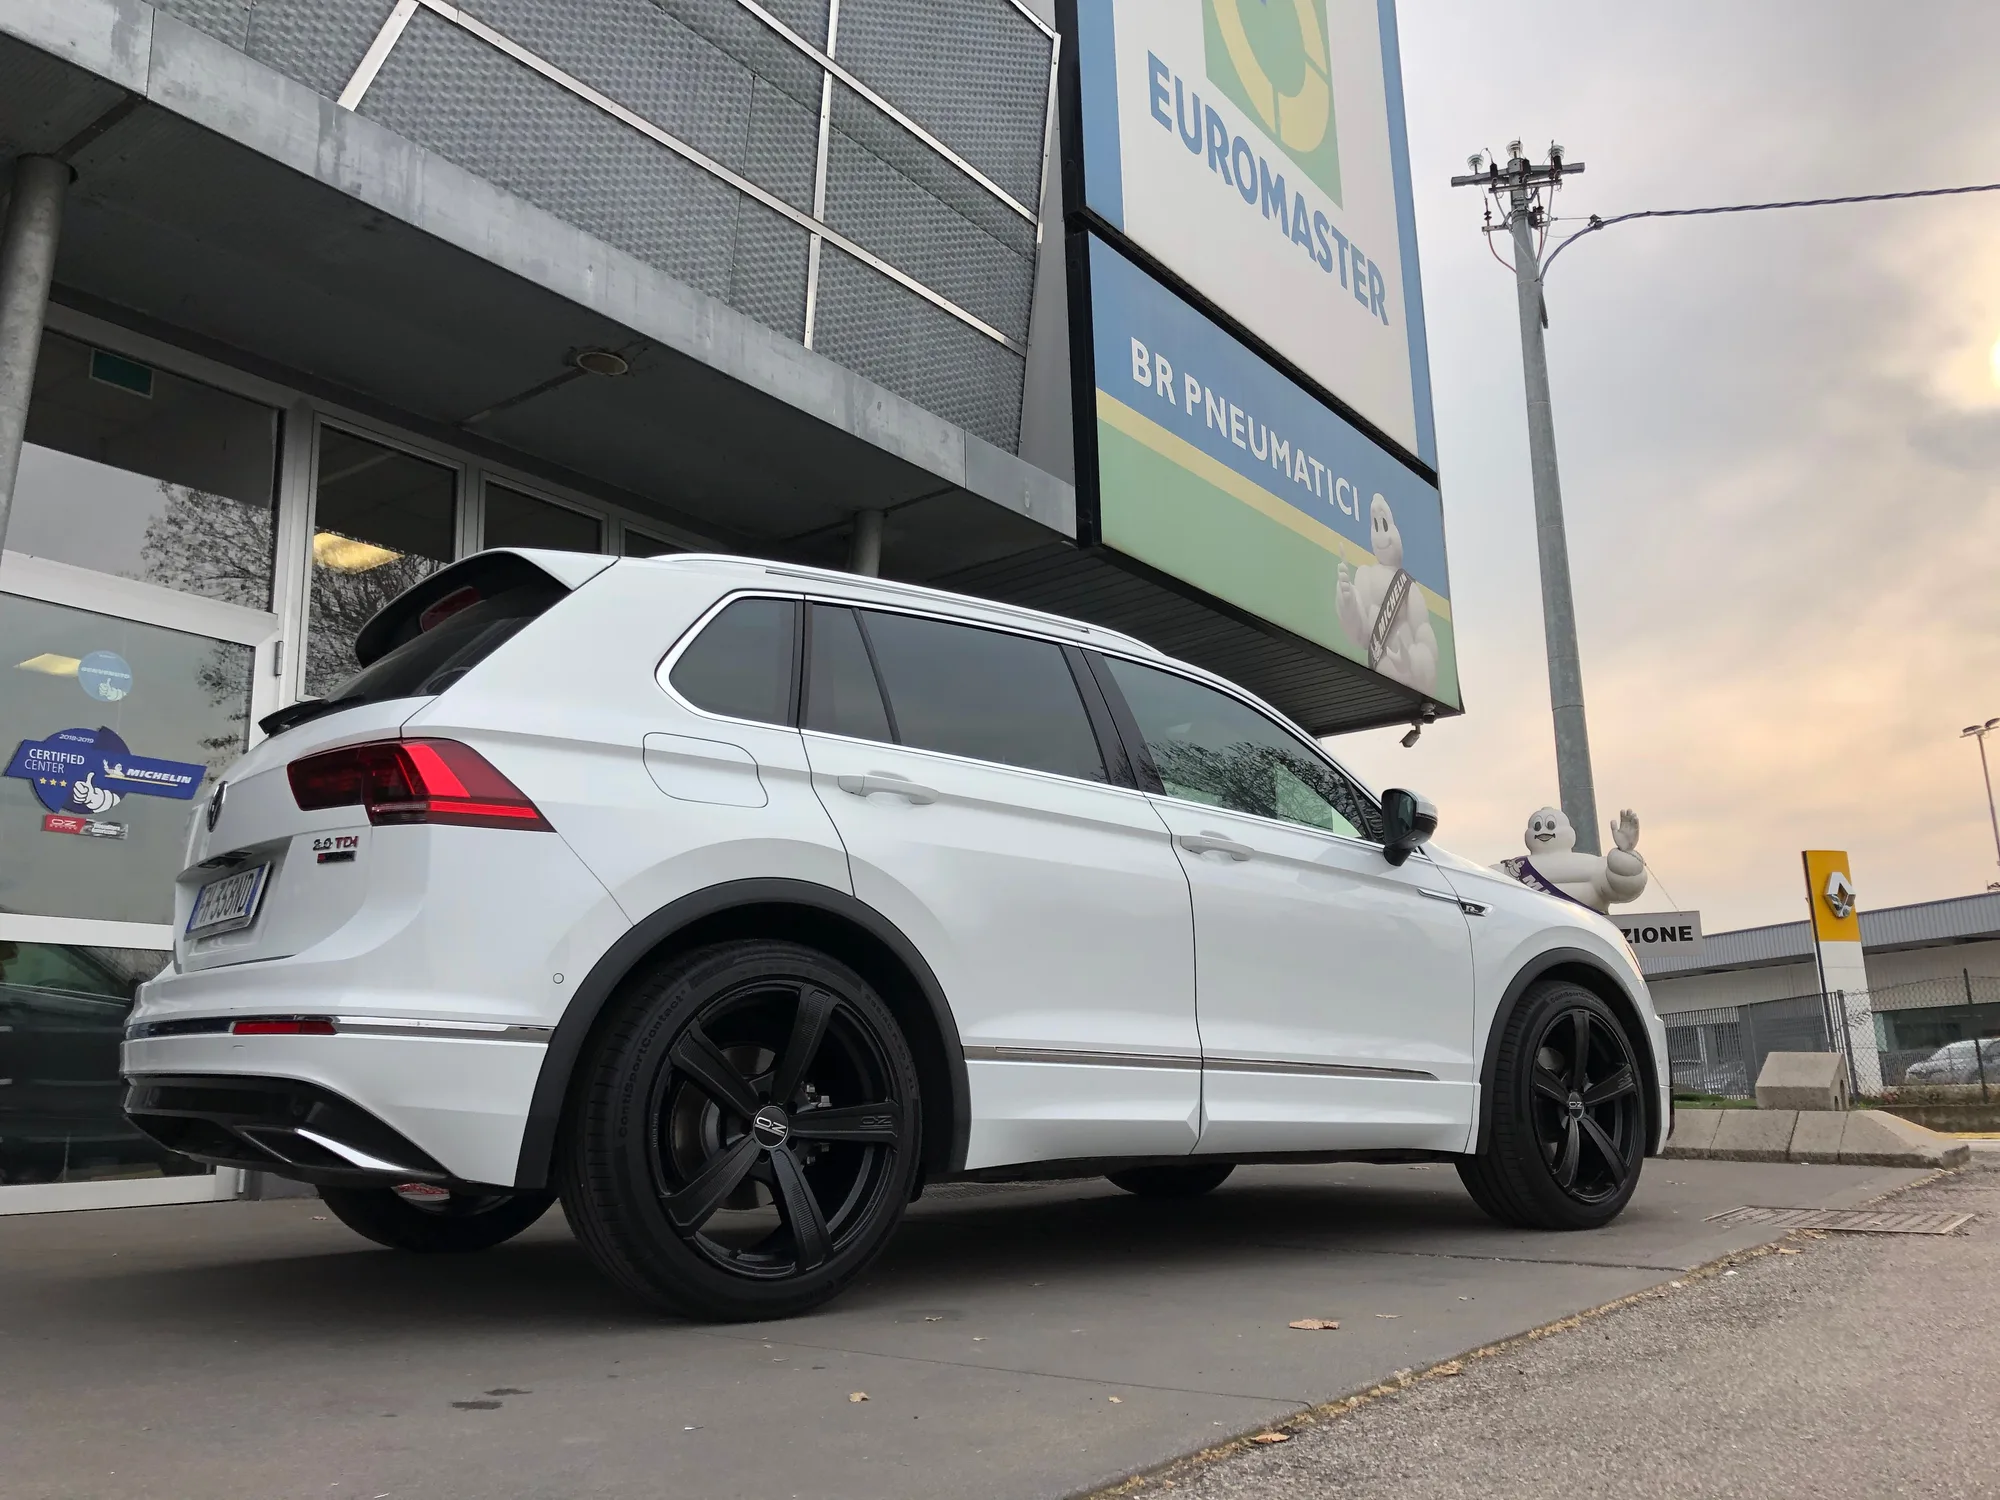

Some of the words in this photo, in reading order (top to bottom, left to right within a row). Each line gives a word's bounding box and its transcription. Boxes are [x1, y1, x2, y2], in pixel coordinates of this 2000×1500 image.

[1147, 49, 1390, 326] EUROMASTER
[1131, 336, 1177, 406] BR
[1184, 372, 1361, 522] PNEUMATICI
[1378, 572, 1408, 640] MICHELIN
[59, 734, 95, 744] 2018-2019
[29, 748, 85, 765] CERTIFIED
[24, 759, 65, 774] CENTER
[126, 768, 192, 784] MICHELIN
[313, 837, 334, 850] 2.0
[335, 835, 359, 848] TDI
